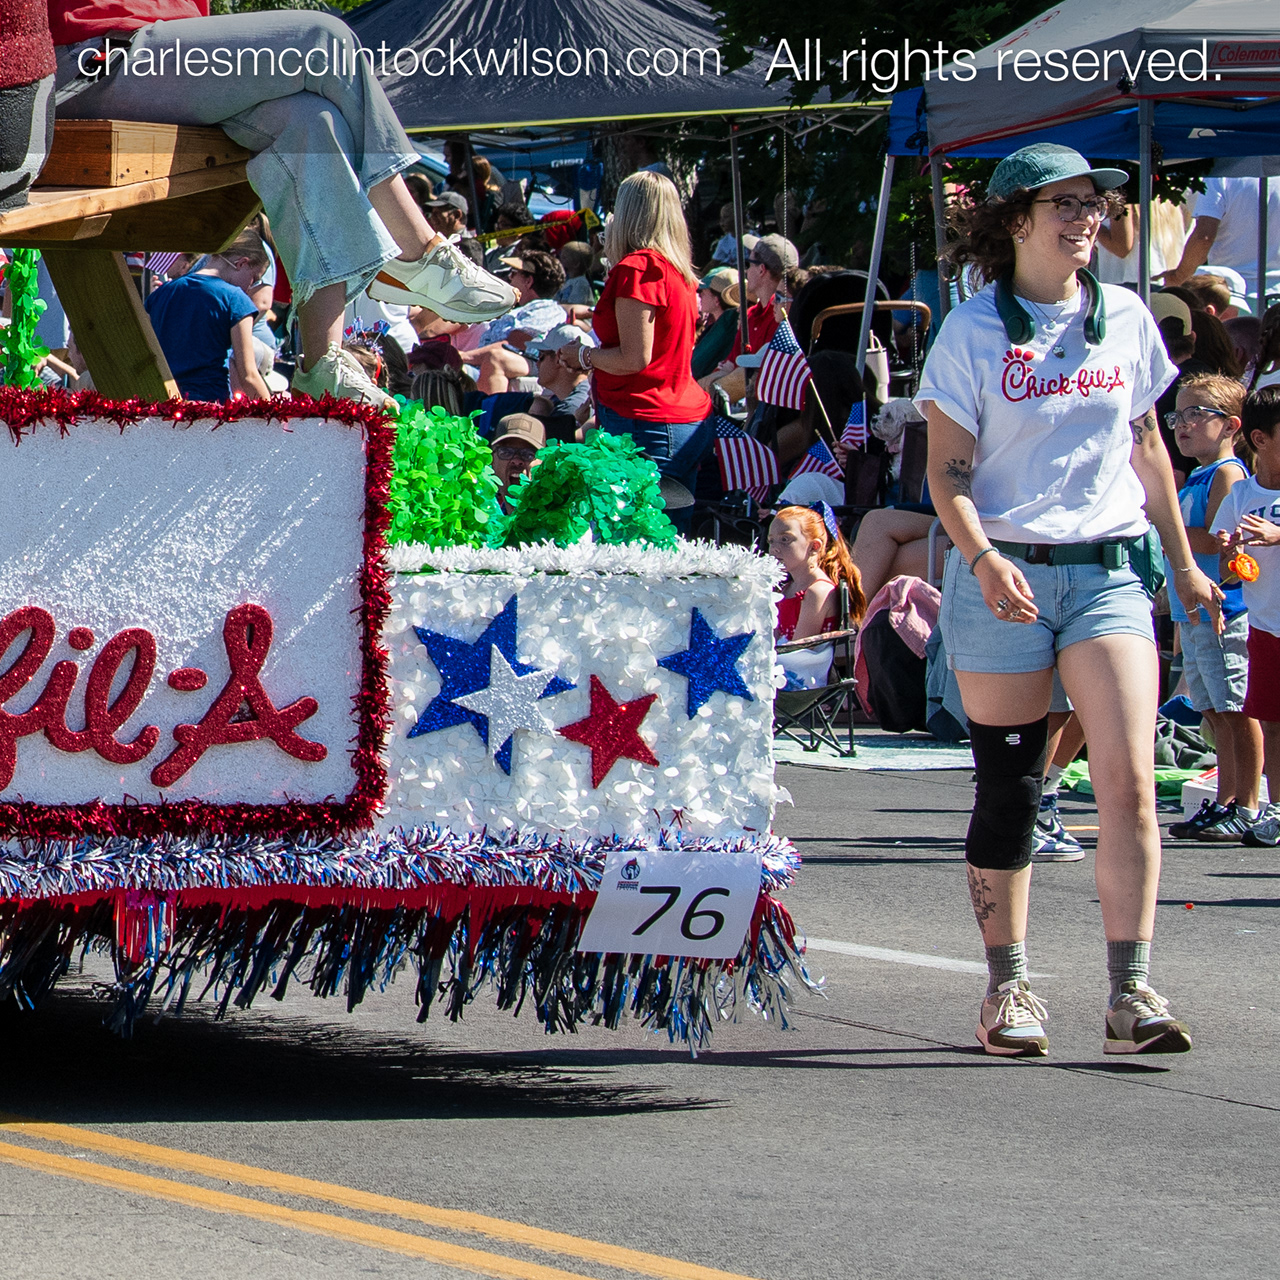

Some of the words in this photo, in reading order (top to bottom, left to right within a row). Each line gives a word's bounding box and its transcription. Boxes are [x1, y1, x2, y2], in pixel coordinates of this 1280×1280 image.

[1217, 44, 1277, 62] Coleman
[1002, 359, 1126, 402] Chick-fil-A
[631, 886, 731, 941] 76
